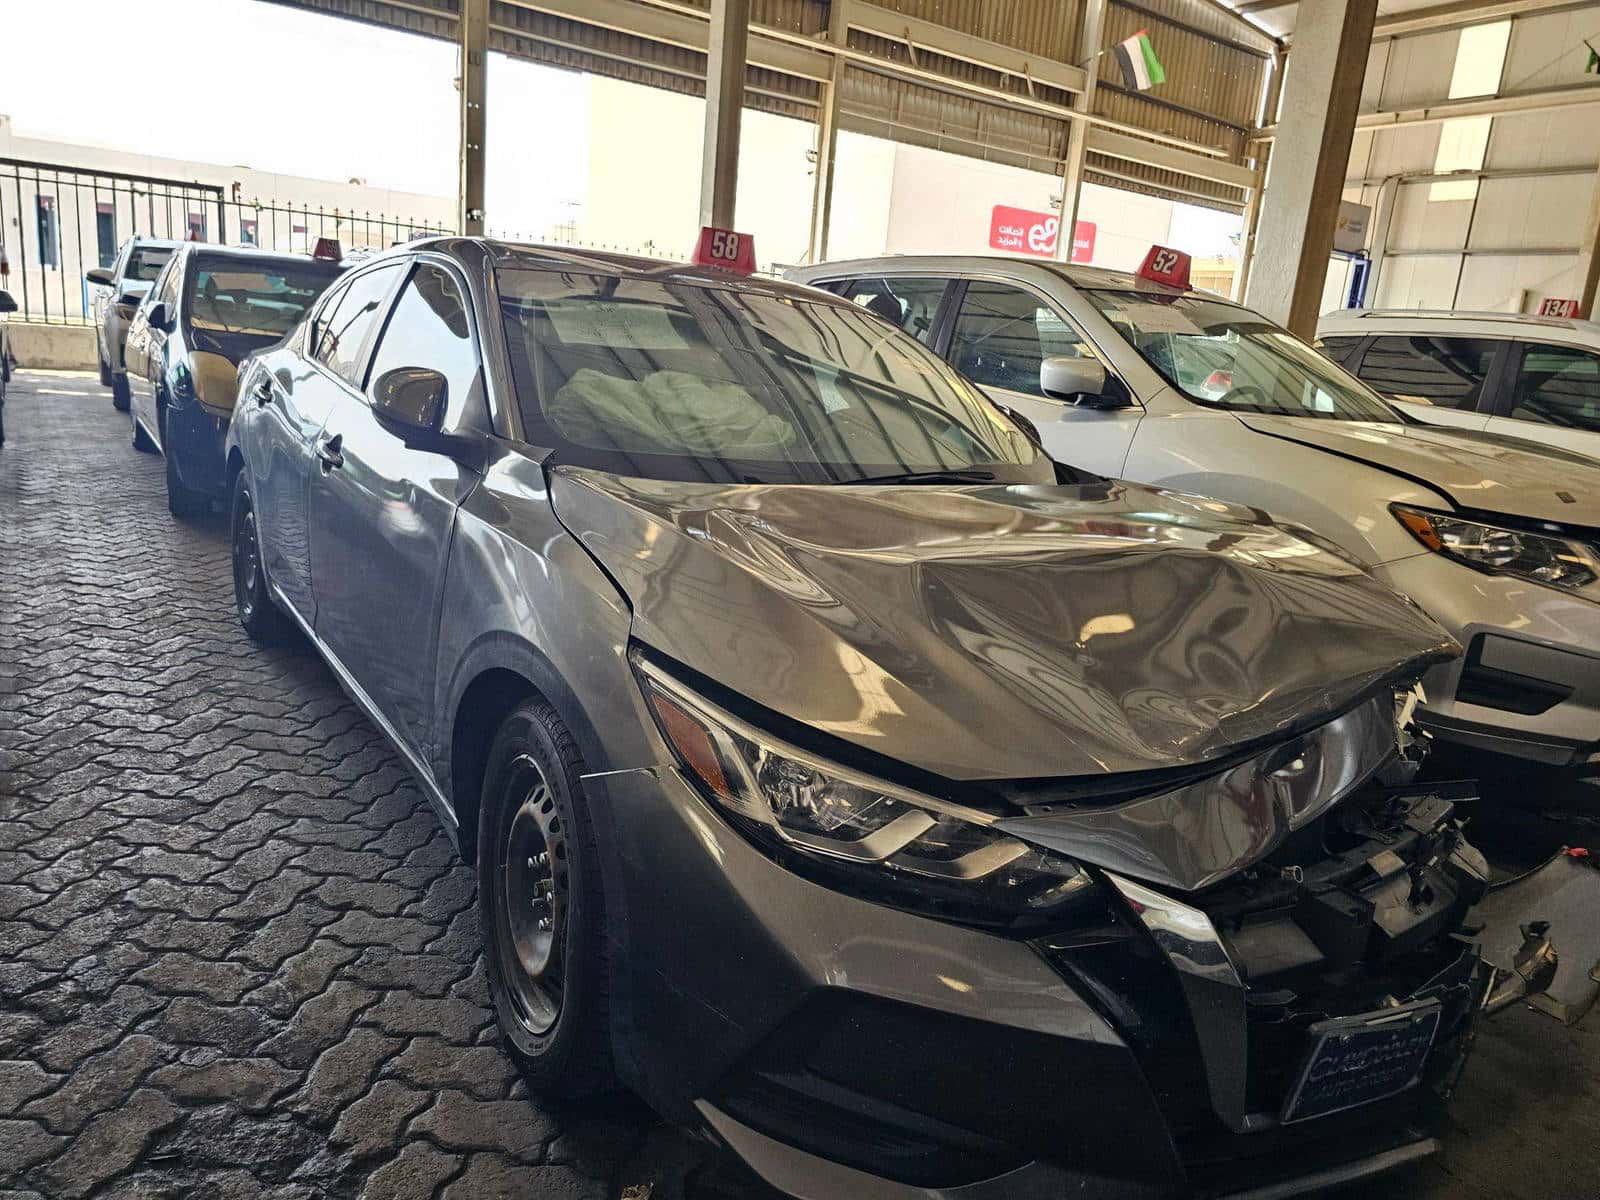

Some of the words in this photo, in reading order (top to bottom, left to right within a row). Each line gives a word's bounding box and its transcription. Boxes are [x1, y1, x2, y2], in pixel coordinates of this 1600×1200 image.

[712, 231, 739, 260] 58
[1152, 249, 1178, 275] 52
[1543, 299, 1570, 318] 134
